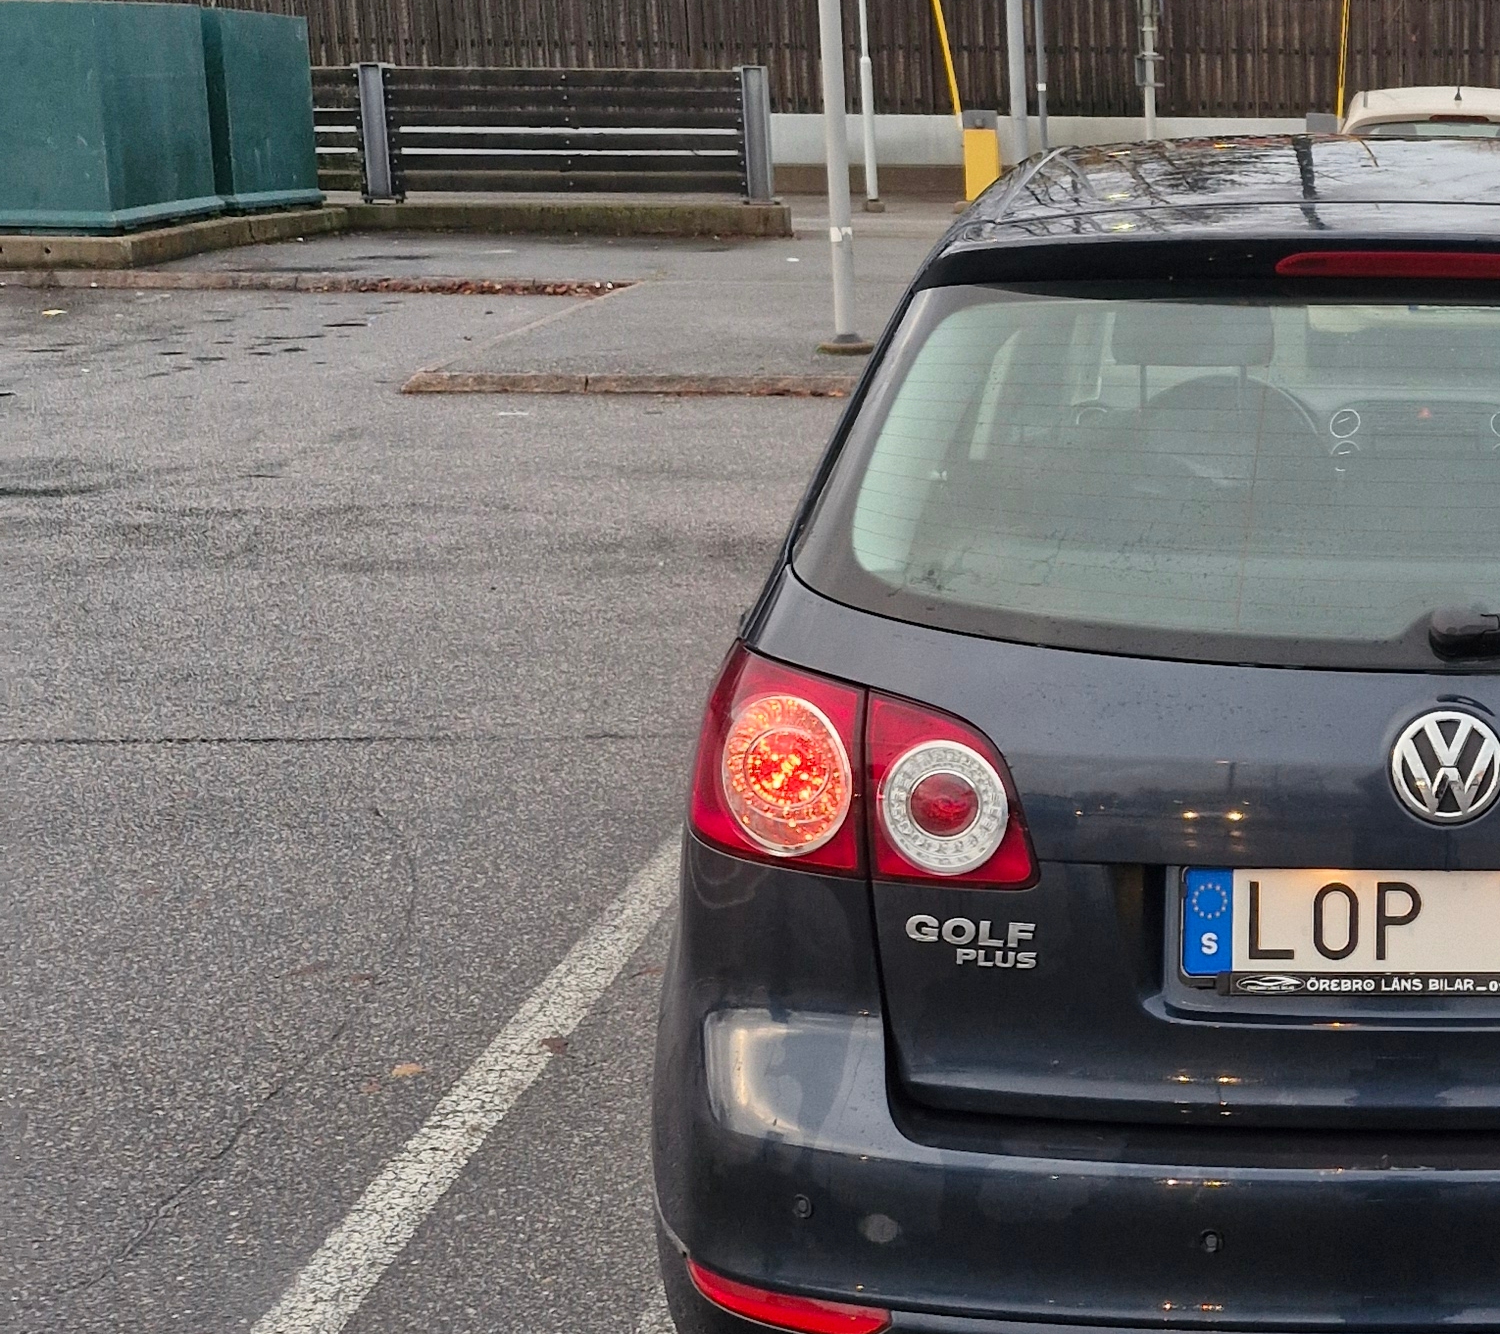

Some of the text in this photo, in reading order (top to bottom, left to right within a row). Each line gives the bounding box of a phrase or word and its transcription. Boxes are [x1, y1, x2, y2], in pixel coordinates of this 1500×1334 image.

[905, 914, 1036, 948] GOLF
[1248, 881, 1422, 961] LOP
[1201, 932, 1218, 955] S
[956, 948, 1037, 969] PLUS
[1306, 976, 1375, 991] ÖREBRO
[1381, 976, 1423, 991] LÄNS
[1428, 978, 1474, 991] BILAR
